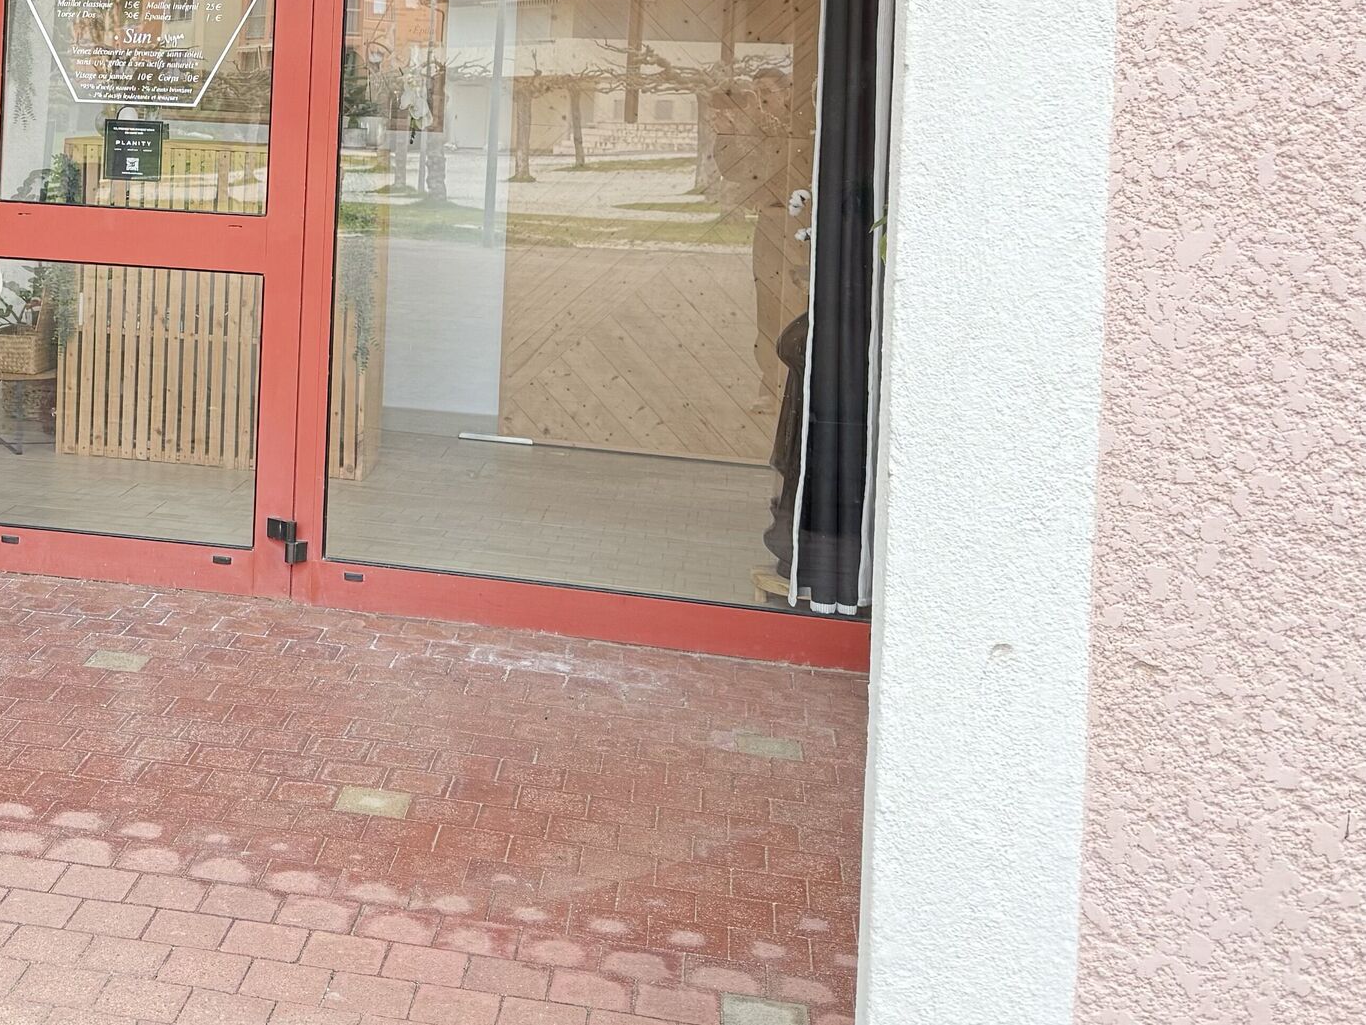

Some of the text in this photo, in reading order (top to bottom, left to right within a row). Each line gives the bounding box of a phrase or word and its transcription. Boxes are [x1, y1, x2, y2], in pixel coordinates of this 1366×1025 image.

[57, 0, 140, 9] Maillot classique 15€
[146, 1, 171, 10] Maillot
[57, 10, 76, 18] Torse
[82, 10, 96, 19] Dos
[123, 28, 152, 44] Sun
[72, 47, 92, 55] Venez
[92, 47, 125, 56] découvrir
[126, 48, 133, 56] le
[107, 59, 127, 68] grâce
[75, 71, 97, 80] Visage
[107, 72, 133, 82] jambes
[137, 72, 153, 81] 10€
[158, 73, 180, 83] Corps
